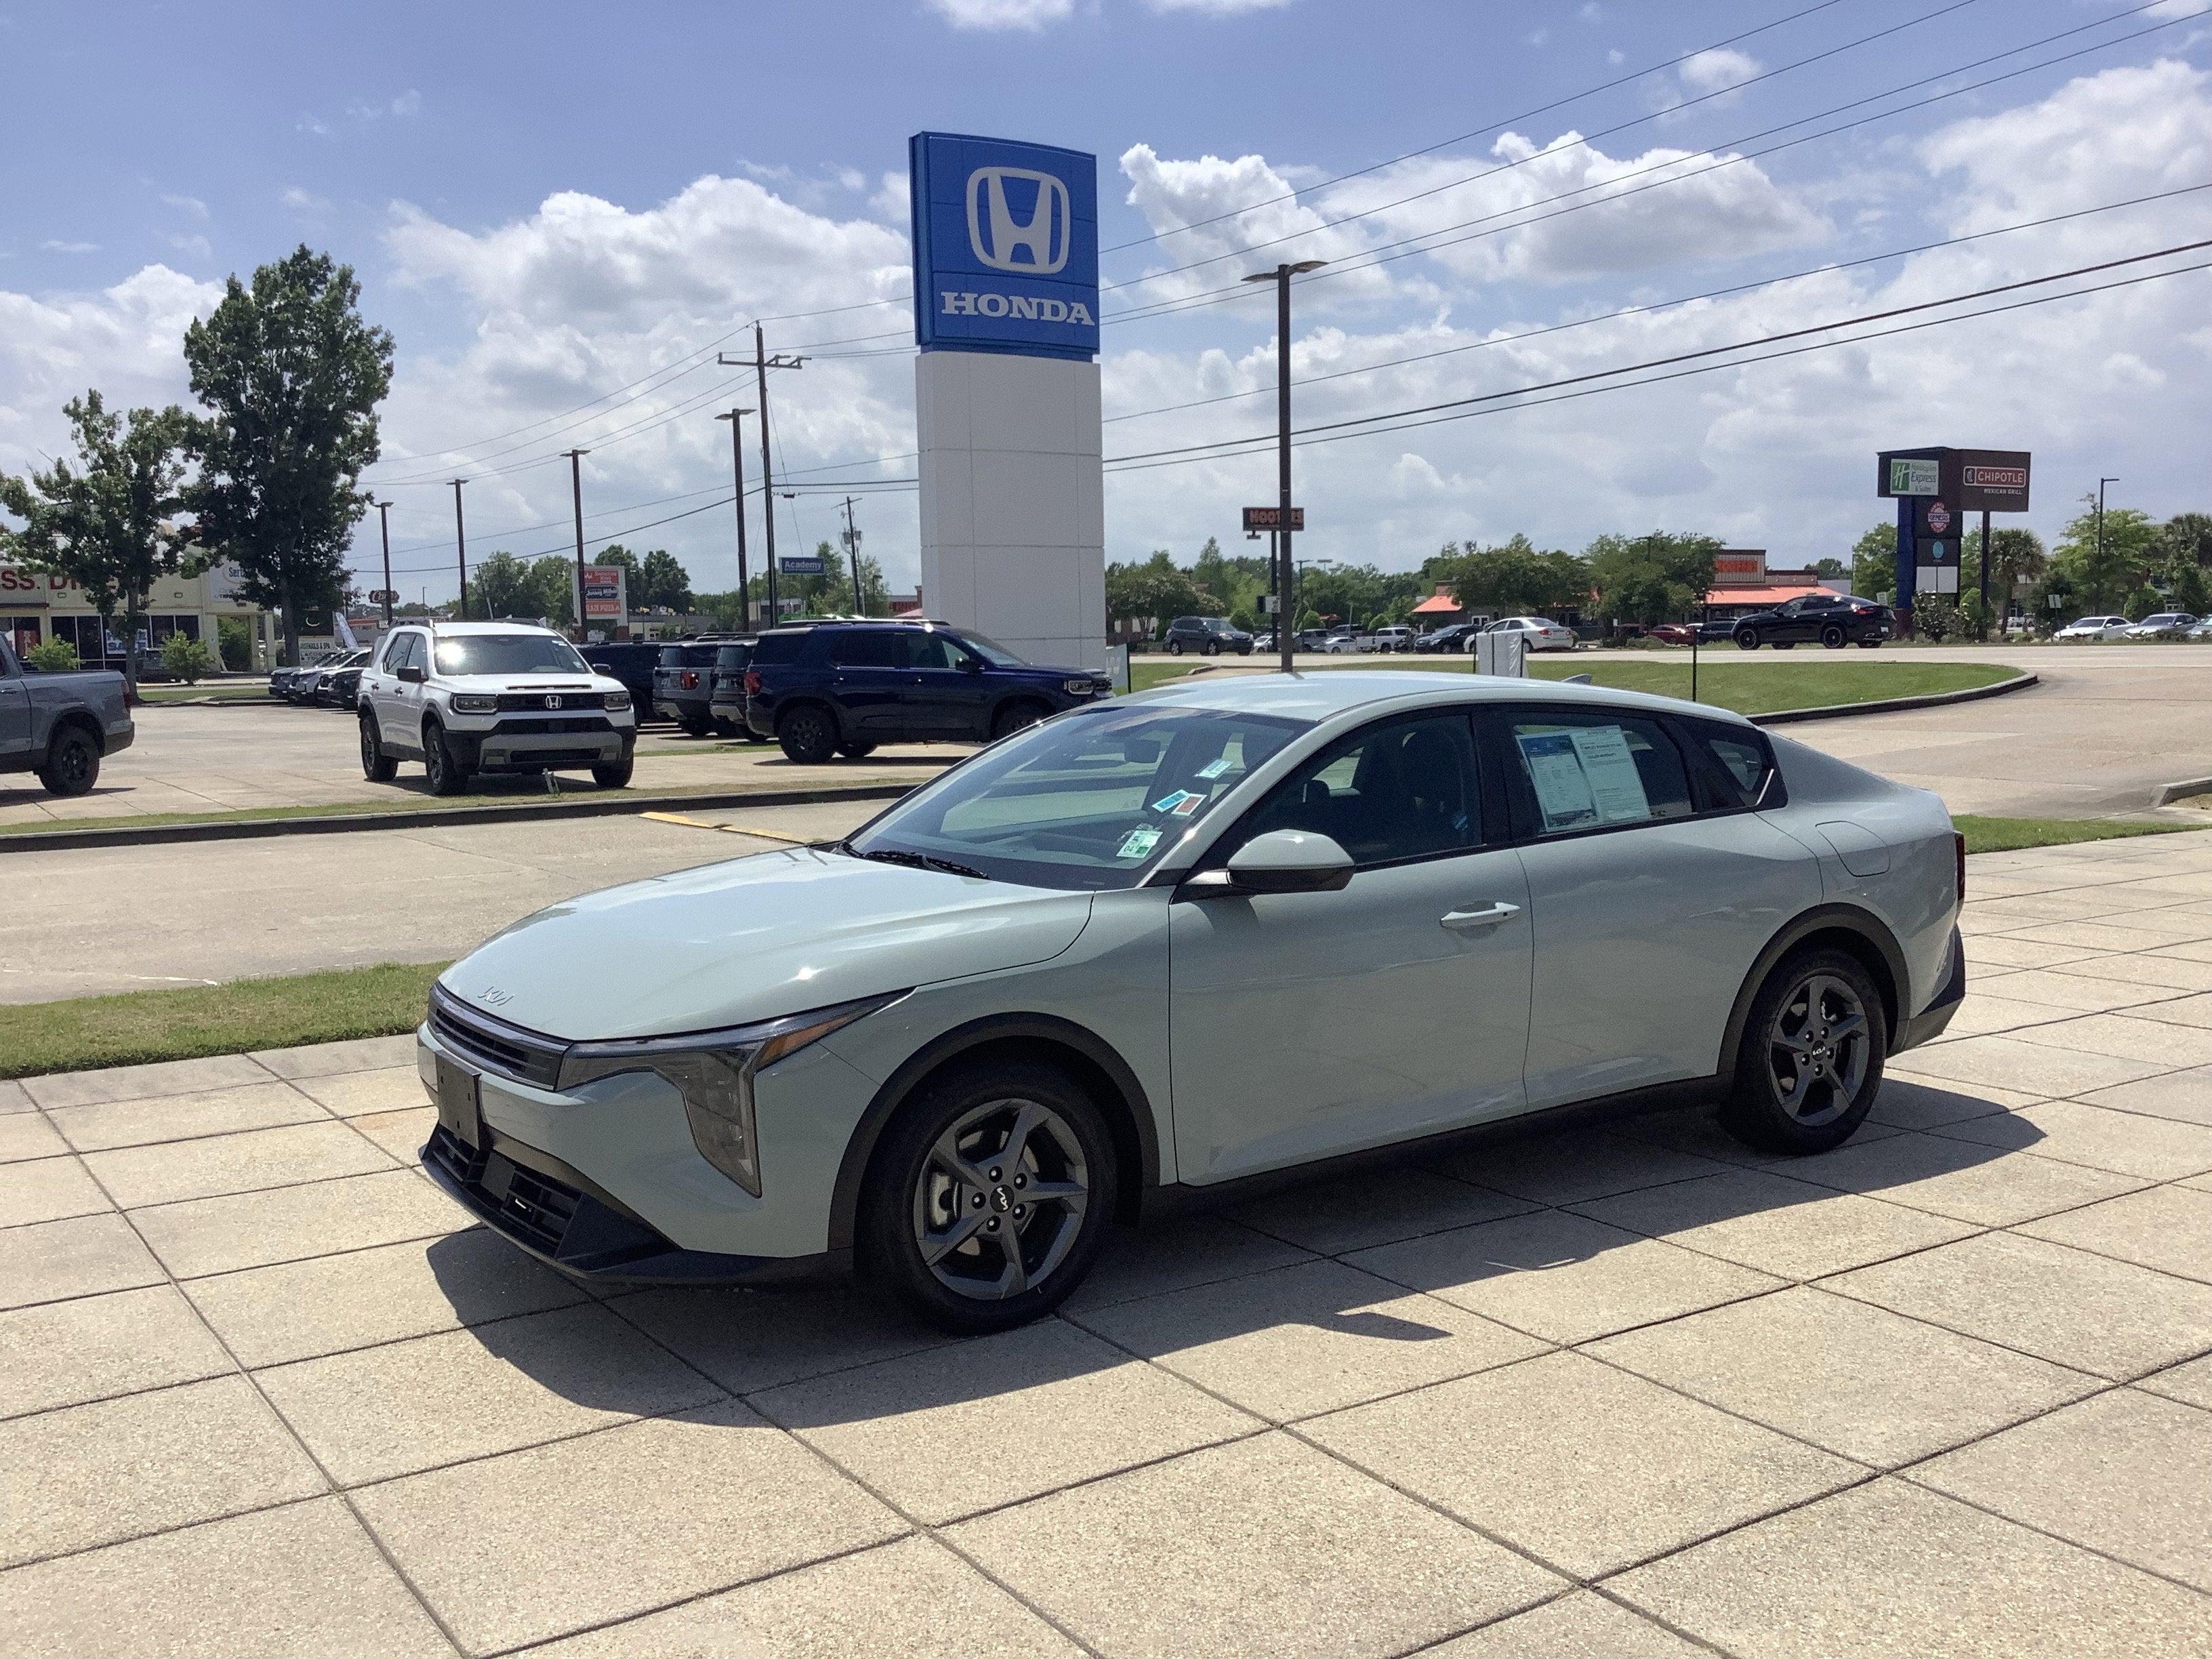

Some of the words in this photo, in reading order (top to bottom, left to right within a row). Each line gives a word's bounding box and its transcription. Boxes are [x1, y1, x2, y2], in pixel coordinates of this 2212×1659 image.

[941, 291, 1095, 326] HONDA
[1911, 471, 1936, 485] Express
[1978, 471, 2023, 483] CHIPOTLE
[1249, 509, 1303, 524] HOOTRS
[784, 560, 822, 571] Academy
